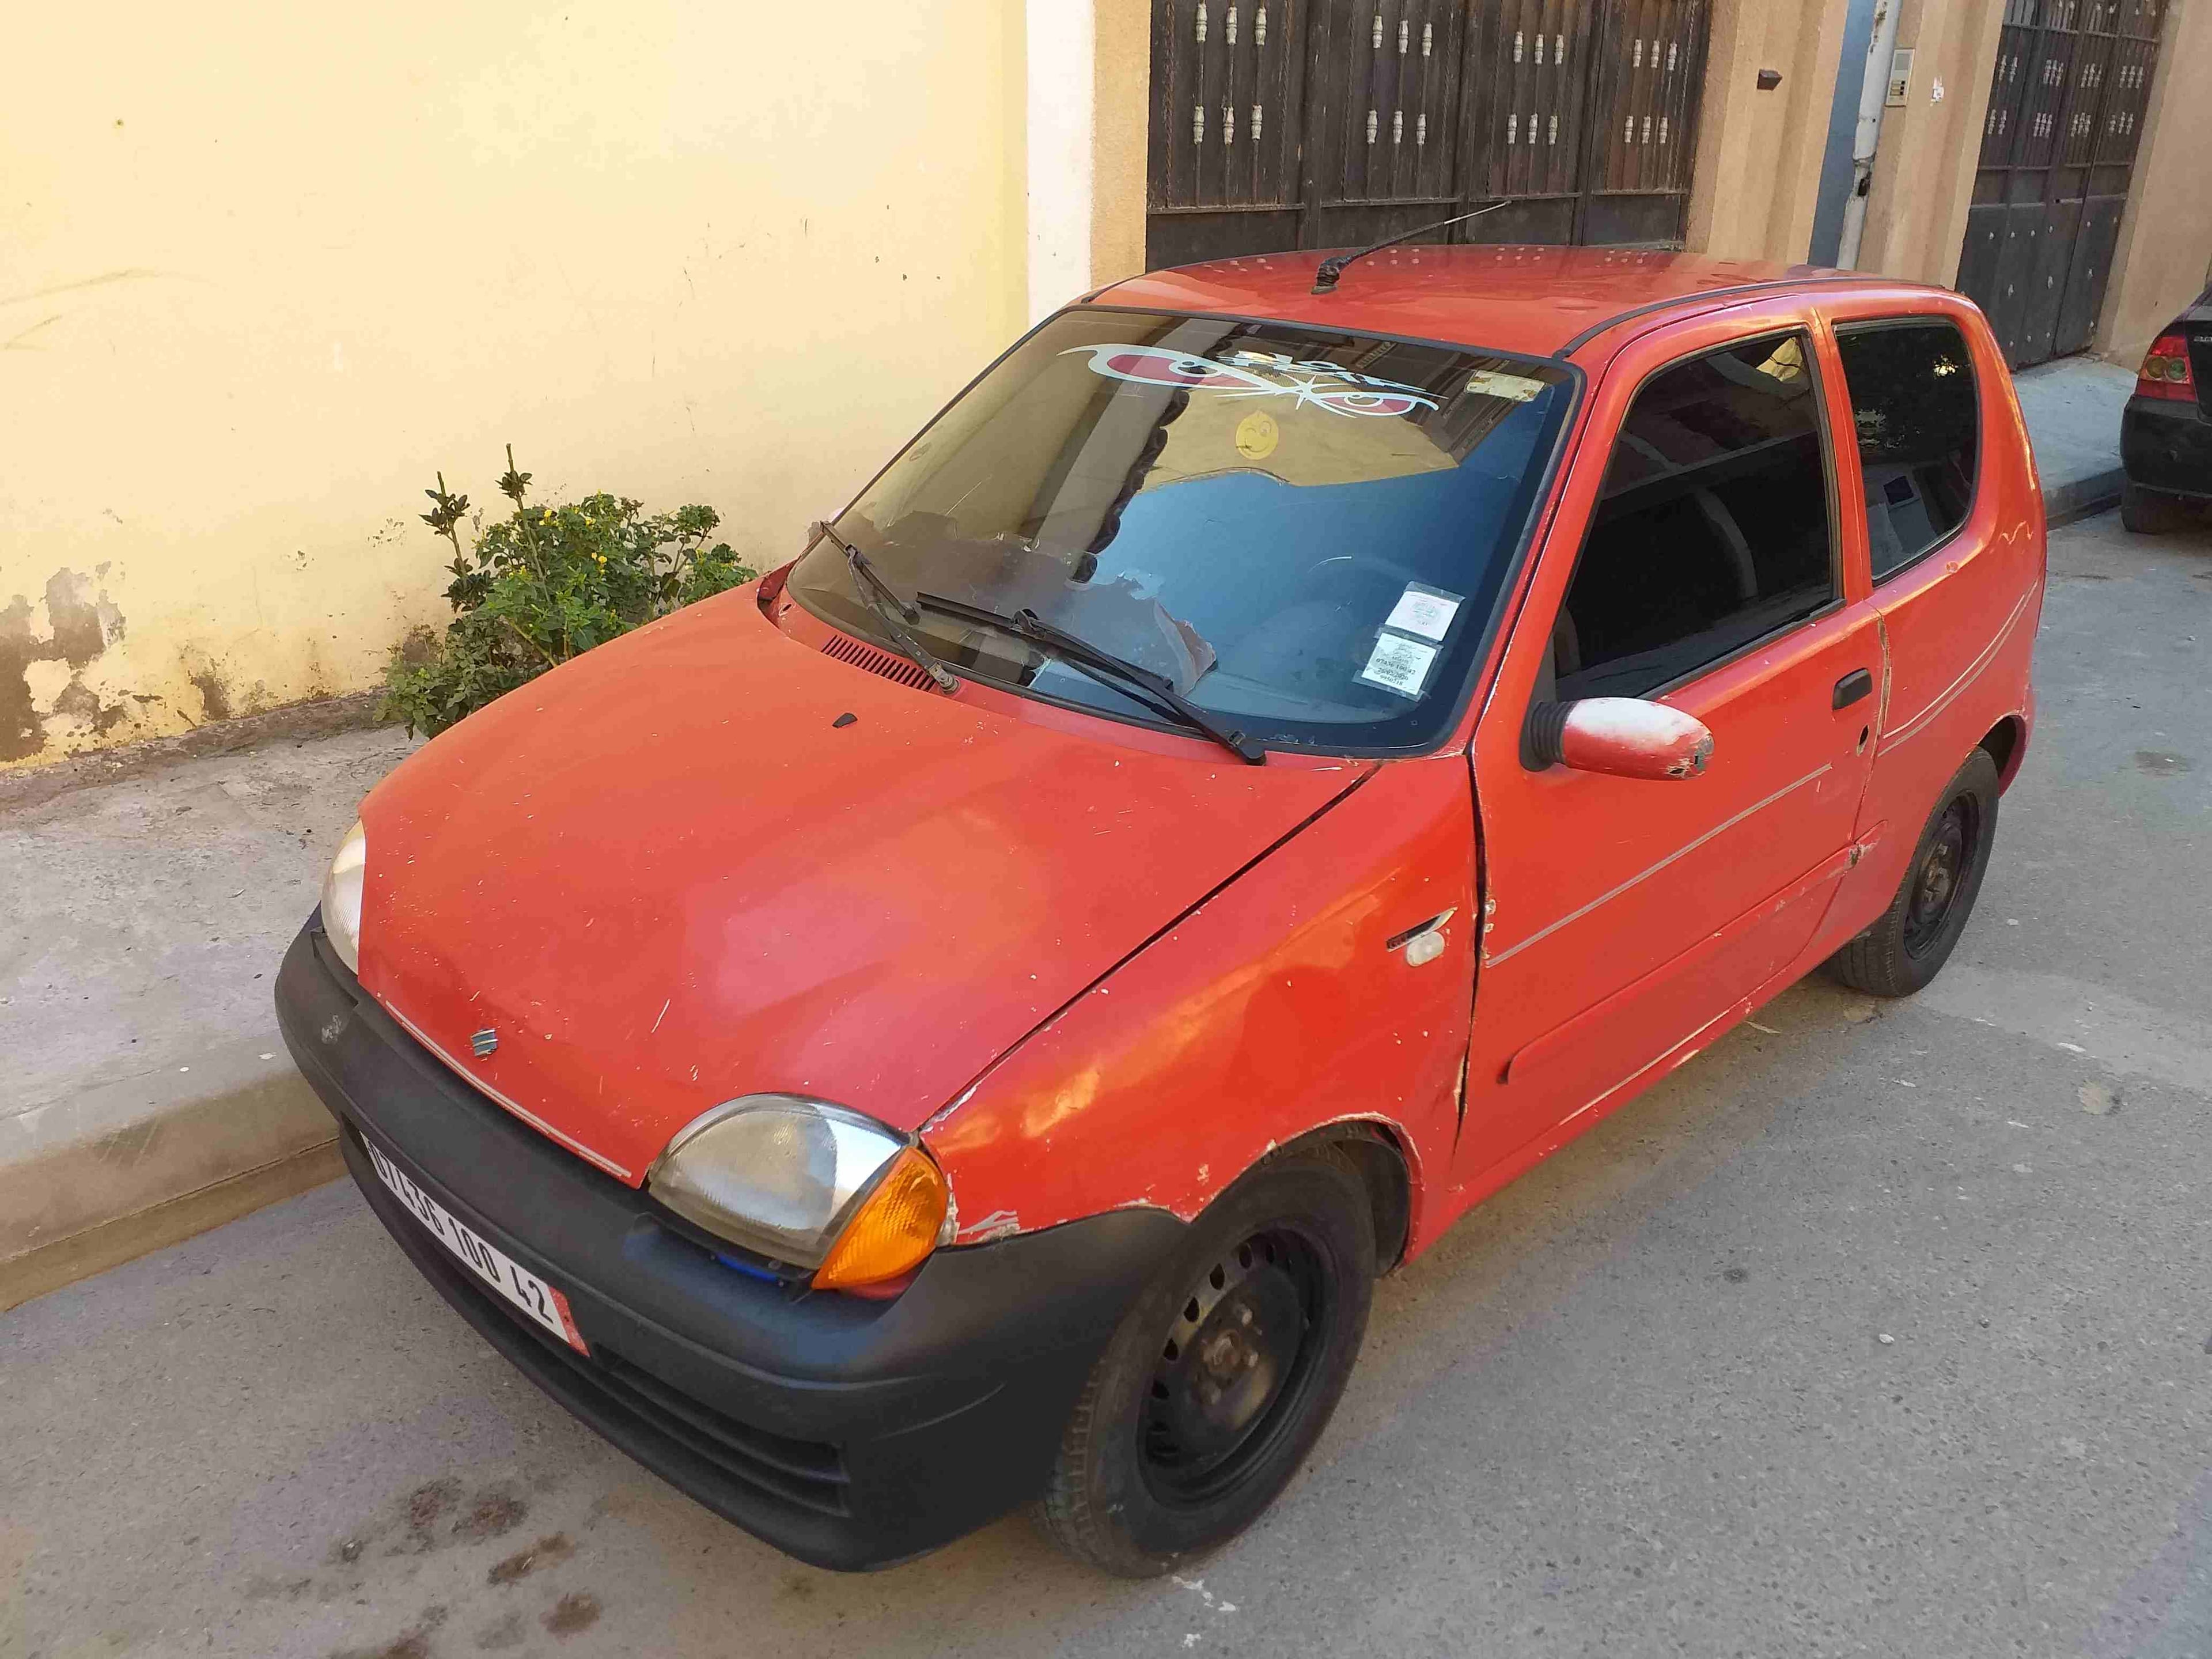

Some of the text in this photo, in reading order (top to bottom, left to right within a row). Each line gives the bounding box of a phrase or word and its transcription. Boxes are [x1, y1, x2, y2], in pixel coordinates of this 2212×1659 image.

[368, 1139, 554, 1324] 07436 100 42
